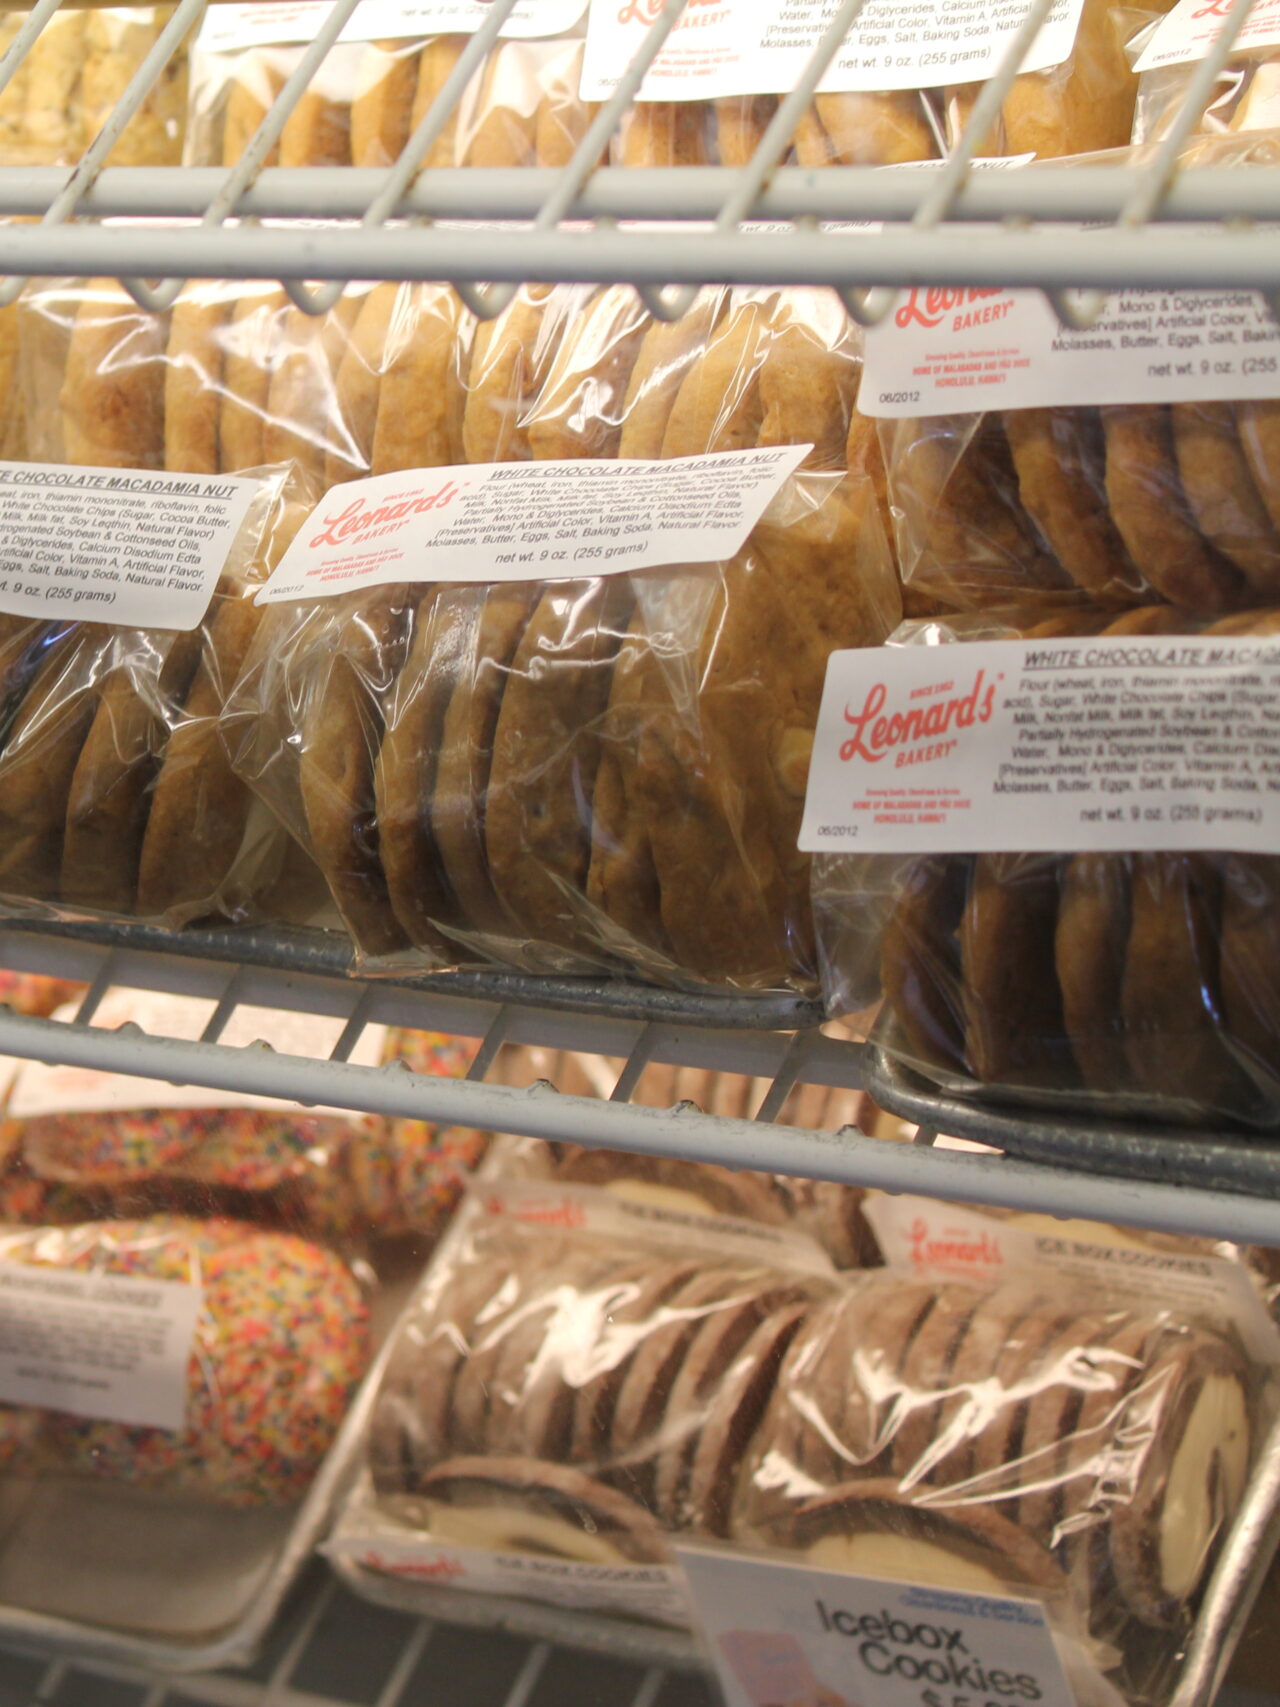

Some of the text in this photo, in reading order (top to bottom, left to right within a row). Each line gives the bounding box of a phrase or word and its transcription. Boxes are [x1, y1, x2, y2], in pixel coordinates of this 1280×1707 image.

[859, 34, 890, 46] Eggs,
[894, 32, 918, 43] Salt,
[923, 29, 959, 41] Baking
[964, 24, 992, 36] Soda,
[838, 47, 991, 69] net wt. 9 oz. (255 grams)
[952, 301, 1010, 332] BAKERY
[1119, 300, 1155, 313] Mono
[1159, 298, 1169, 311] &
[1155, 314, 1206, 329] Artificial
[1051, 331, 1238, 351] Molasses, Butter, Eggs, Salt,
[1148, 362, 1171, 377] net
[1175, 361, 1195, 375] wt.
[1200, 359, 1209, 375] 9
[1213, 361, 1235, 374] oz.
[878, 391, 920, 404] 06/2012
[490, 452, 788, 480] WHITE CHOCOLATE MACADAMIA NUT
[13, 470, 106, 488] CHOCOLATE
[106, 476, 201, 496] MACADAMIA
[202, 484, 239, 499] NUT
[2, 501, 31, 511] White
[33, 502, 85, 514] Chocolate
[86, 505, 117, 518] Chips
[118, 508, 156, 522] (Sugar,
[159, 512, 194, 524] Cocoa
[196, 515, 231, 529] Butter,
[45, 490, 83, 502] thiamin
[204, 502, 227, 516] folic
[1, 511, 24, 522] Milk,
[27, 513, 48, 522] Milk
[51, 514, 66, 524] fat,
[69, 514, 90, 526] Soy
[135, 521, 176, 535] Natural
[176, 526, 215, 541] Flavor)
[352, 520, 403, 545] BAKERY
[425, 535, 477, 548] Molasses,
[481, 533, 516, 545] Butter,
[520, 531, 550, 543] Eggs,
[555, 528, 577, 540] Salt,
[582, 525, 620, 538] Baking
[623, 523, 653, 535] Soda,
[657, 521, 700, 531] Natural
[1, 535, 9, 545] &
[11, 536, 75, 553] Diglycerides,
[78, 540, 121, 555] Calcium
[123, 545, 176, 562] Disodium
[176, 553, 202, 565] Edta
[55, 527, 102, 541] Soybean
[104, 531, 113, 541] &
[114, 531, 176, 548] Cottonseed
[178, 539, 201, 552] Oils,
[495, 540, 648, 564] net wt. 9 oz. (255 grams)
[28, 563, 51, 576] Salt,
[54, 565, 89, 581] Baking
[91, 569, 121, 582] Soda,
[124, 572, 165, 588] Natural
[35, 550, 65, 564] Color,
[70, 553, 108, 567] Vitamin
[122, 557, 168, 575] Artificial
[169, 565, 205, 581] Flavor,
[13, 582, 23, 593] 9
[24, 585, 41, 597] oz.
[45, 585, 74, 600] (255
[73, 589, 117, 605] grams)
[1024, 647, 1202, 668] WHITE CHOCOLATE
[839, 668, 997, 764] Leonard's
[894, 742, 953, 769] BAKERY
[817, 825, 858, 838] 06/2012
[815, 1599, 969, 1655] Icebox
[859, 1641, 1042, 1701] Cookies
